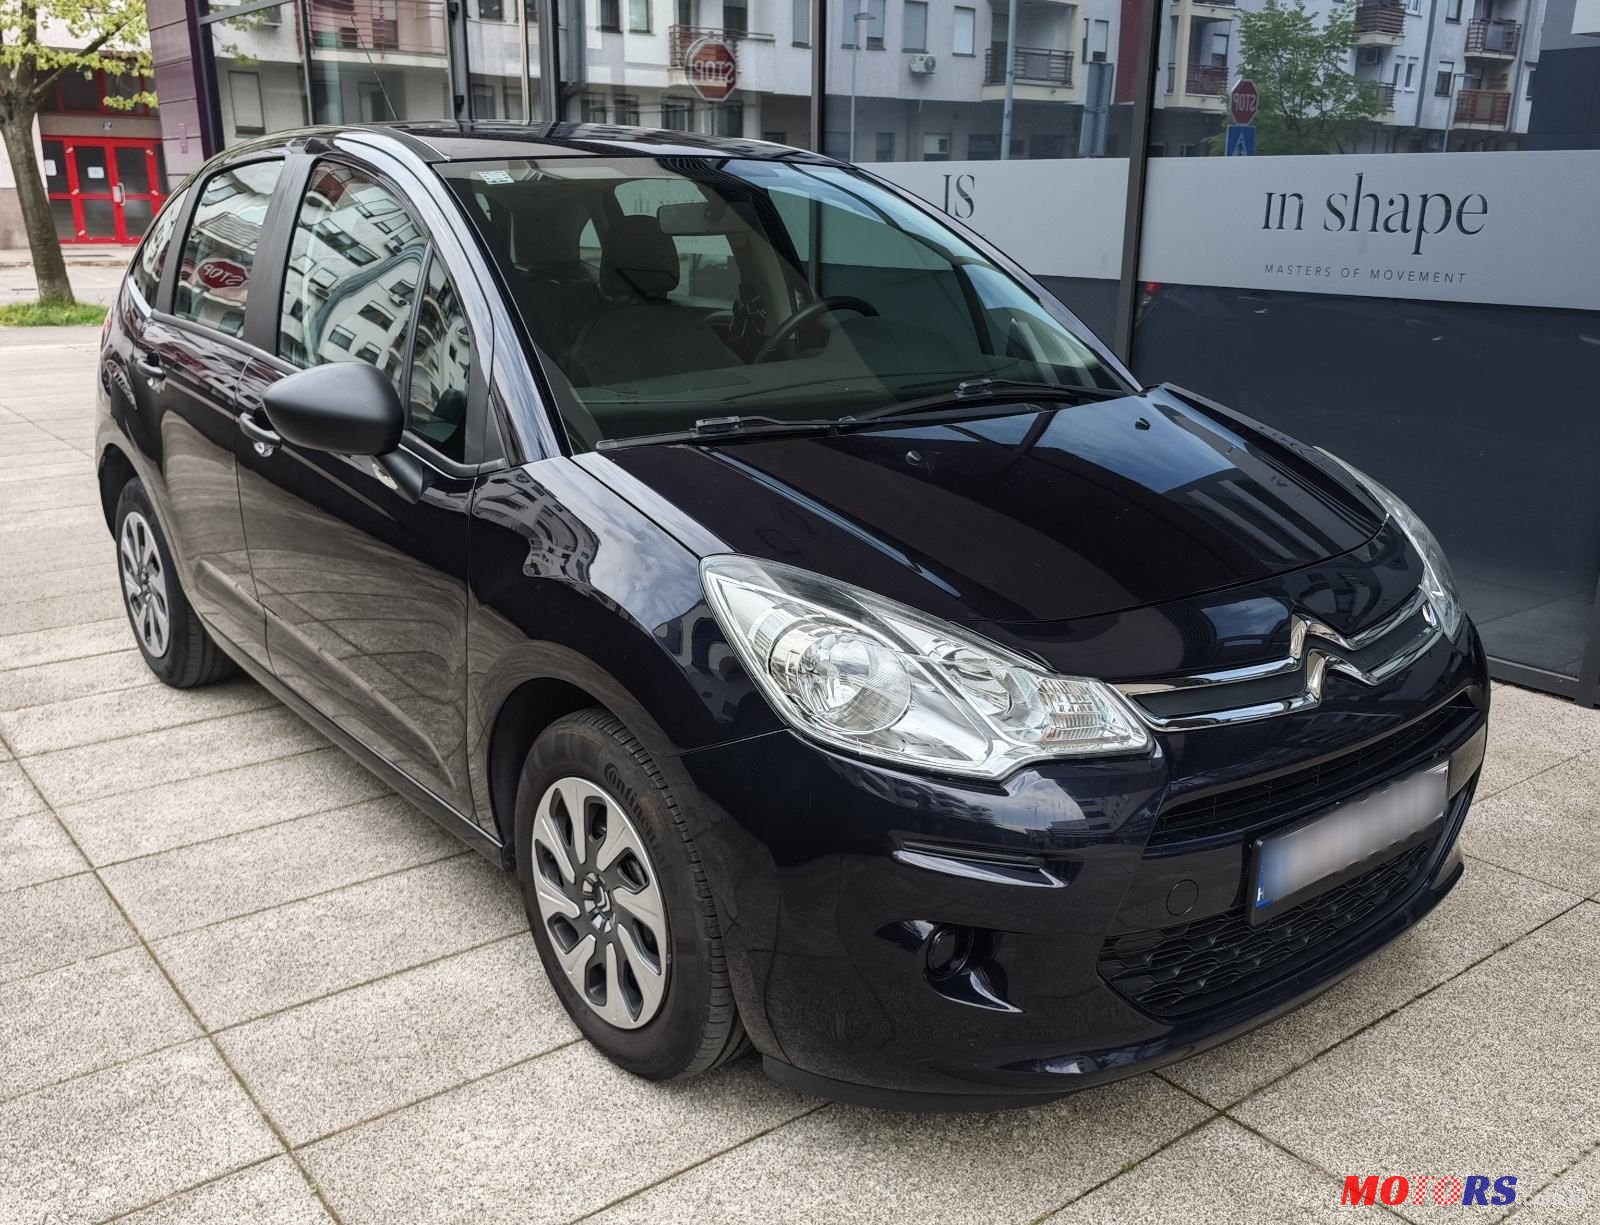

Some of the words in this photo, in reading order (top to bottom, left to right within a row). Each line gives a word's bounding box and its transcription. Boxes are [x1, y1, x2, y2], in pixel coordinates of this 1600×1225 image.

[1322, 172, 1488, 256] shape
[1264, 263, 1332, 277] MASTERS
[1340, 267, 1361, 279] OF
[1369, 269, 1467, 284] MOVEMENT
